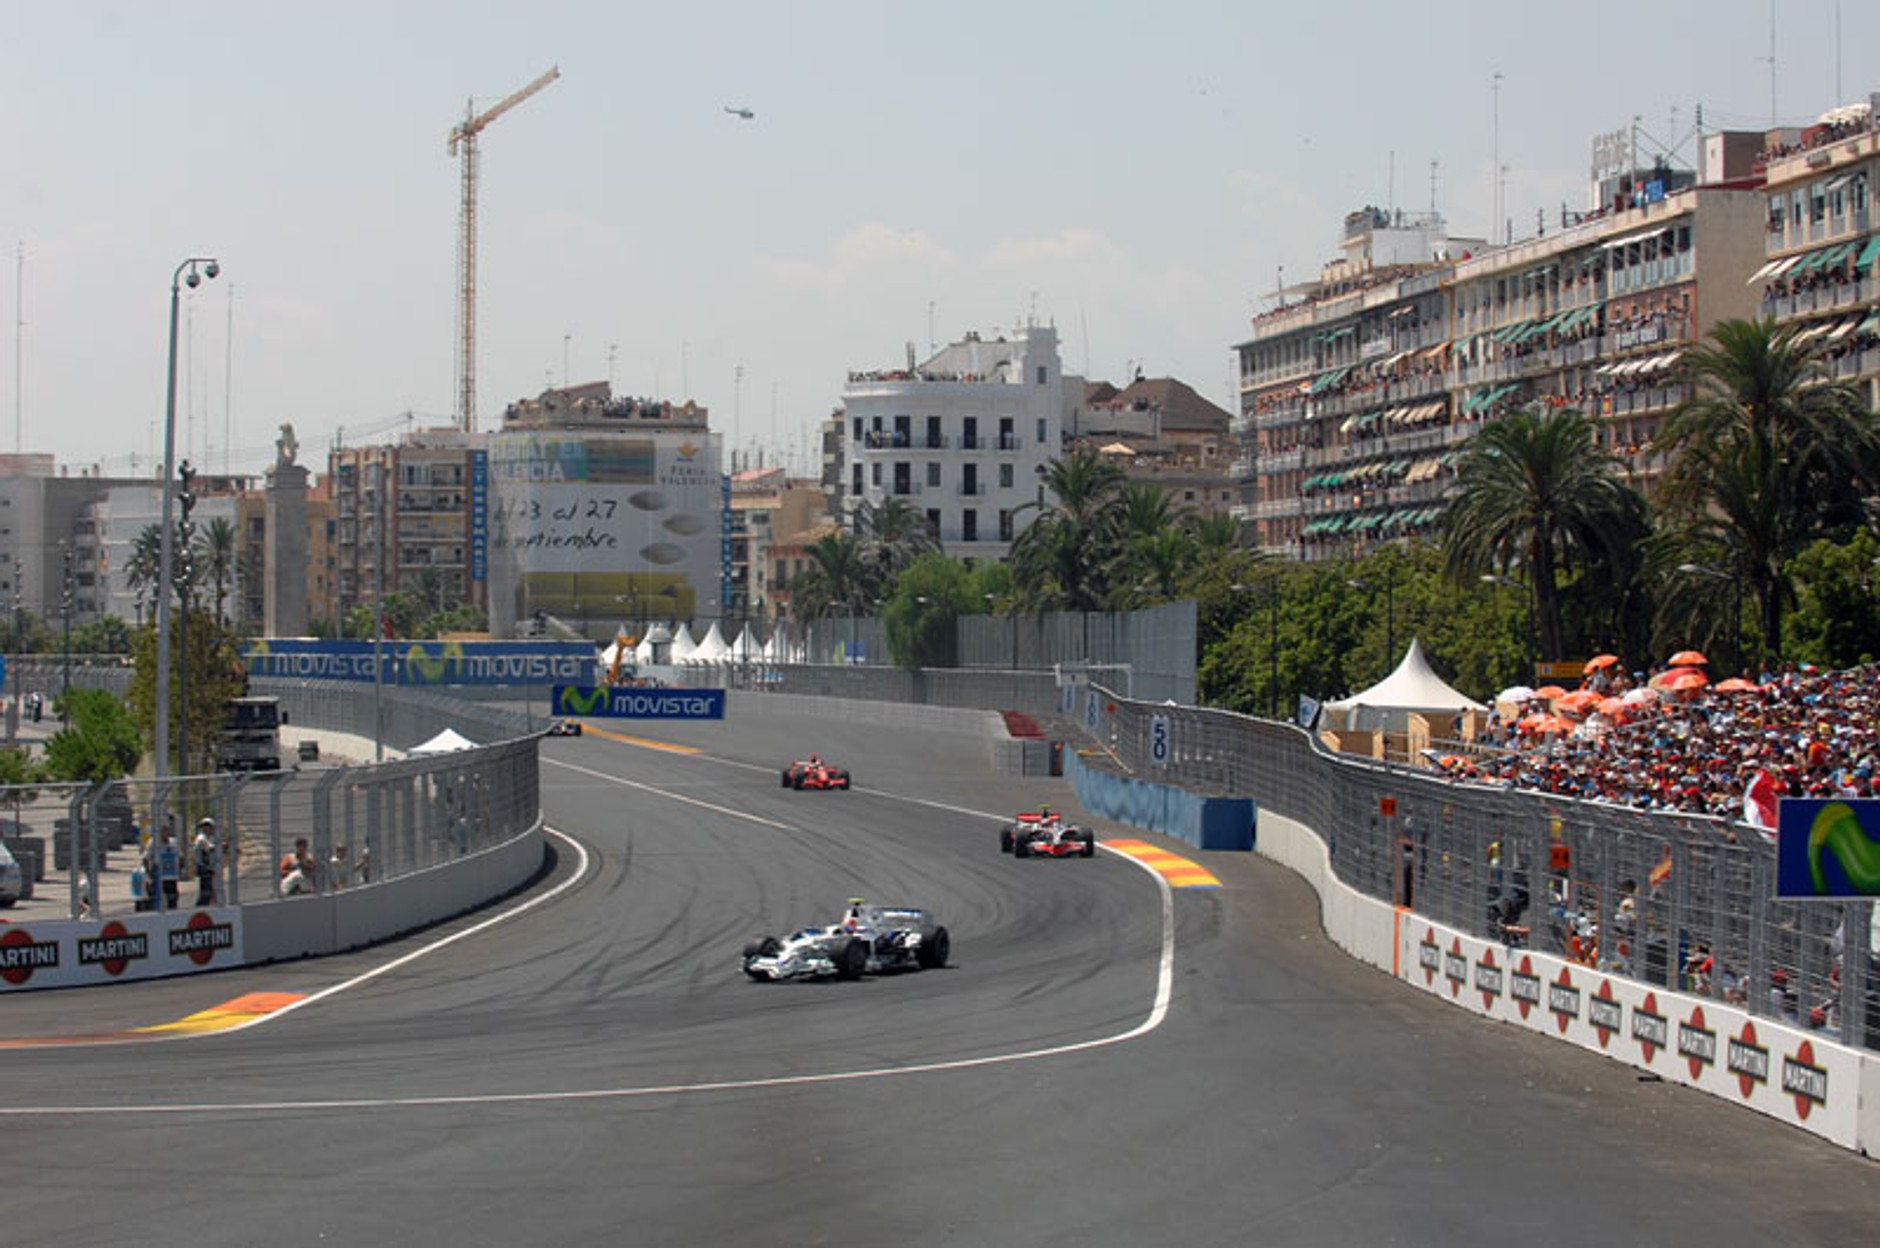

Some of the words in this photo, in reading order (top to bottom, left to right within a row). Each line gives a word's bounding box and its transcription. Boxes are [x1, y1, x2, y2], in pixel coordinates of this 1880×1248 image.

[586, 500, 617, 519] 27
[469, 655, 585, 678] movistar
[614, 694, 716, 715] movistar
[1153, 723, 1167, 760] 50
[82, 939, 146, 961] MARTINI
[171, 928, 231, 951] MARTINI
[1681, 1026, 1715, 1062] MARTINI
[1730, 1043, 1767, 1081] MARTINI
[1786, 1059, 1826, 1101] MARTINI
